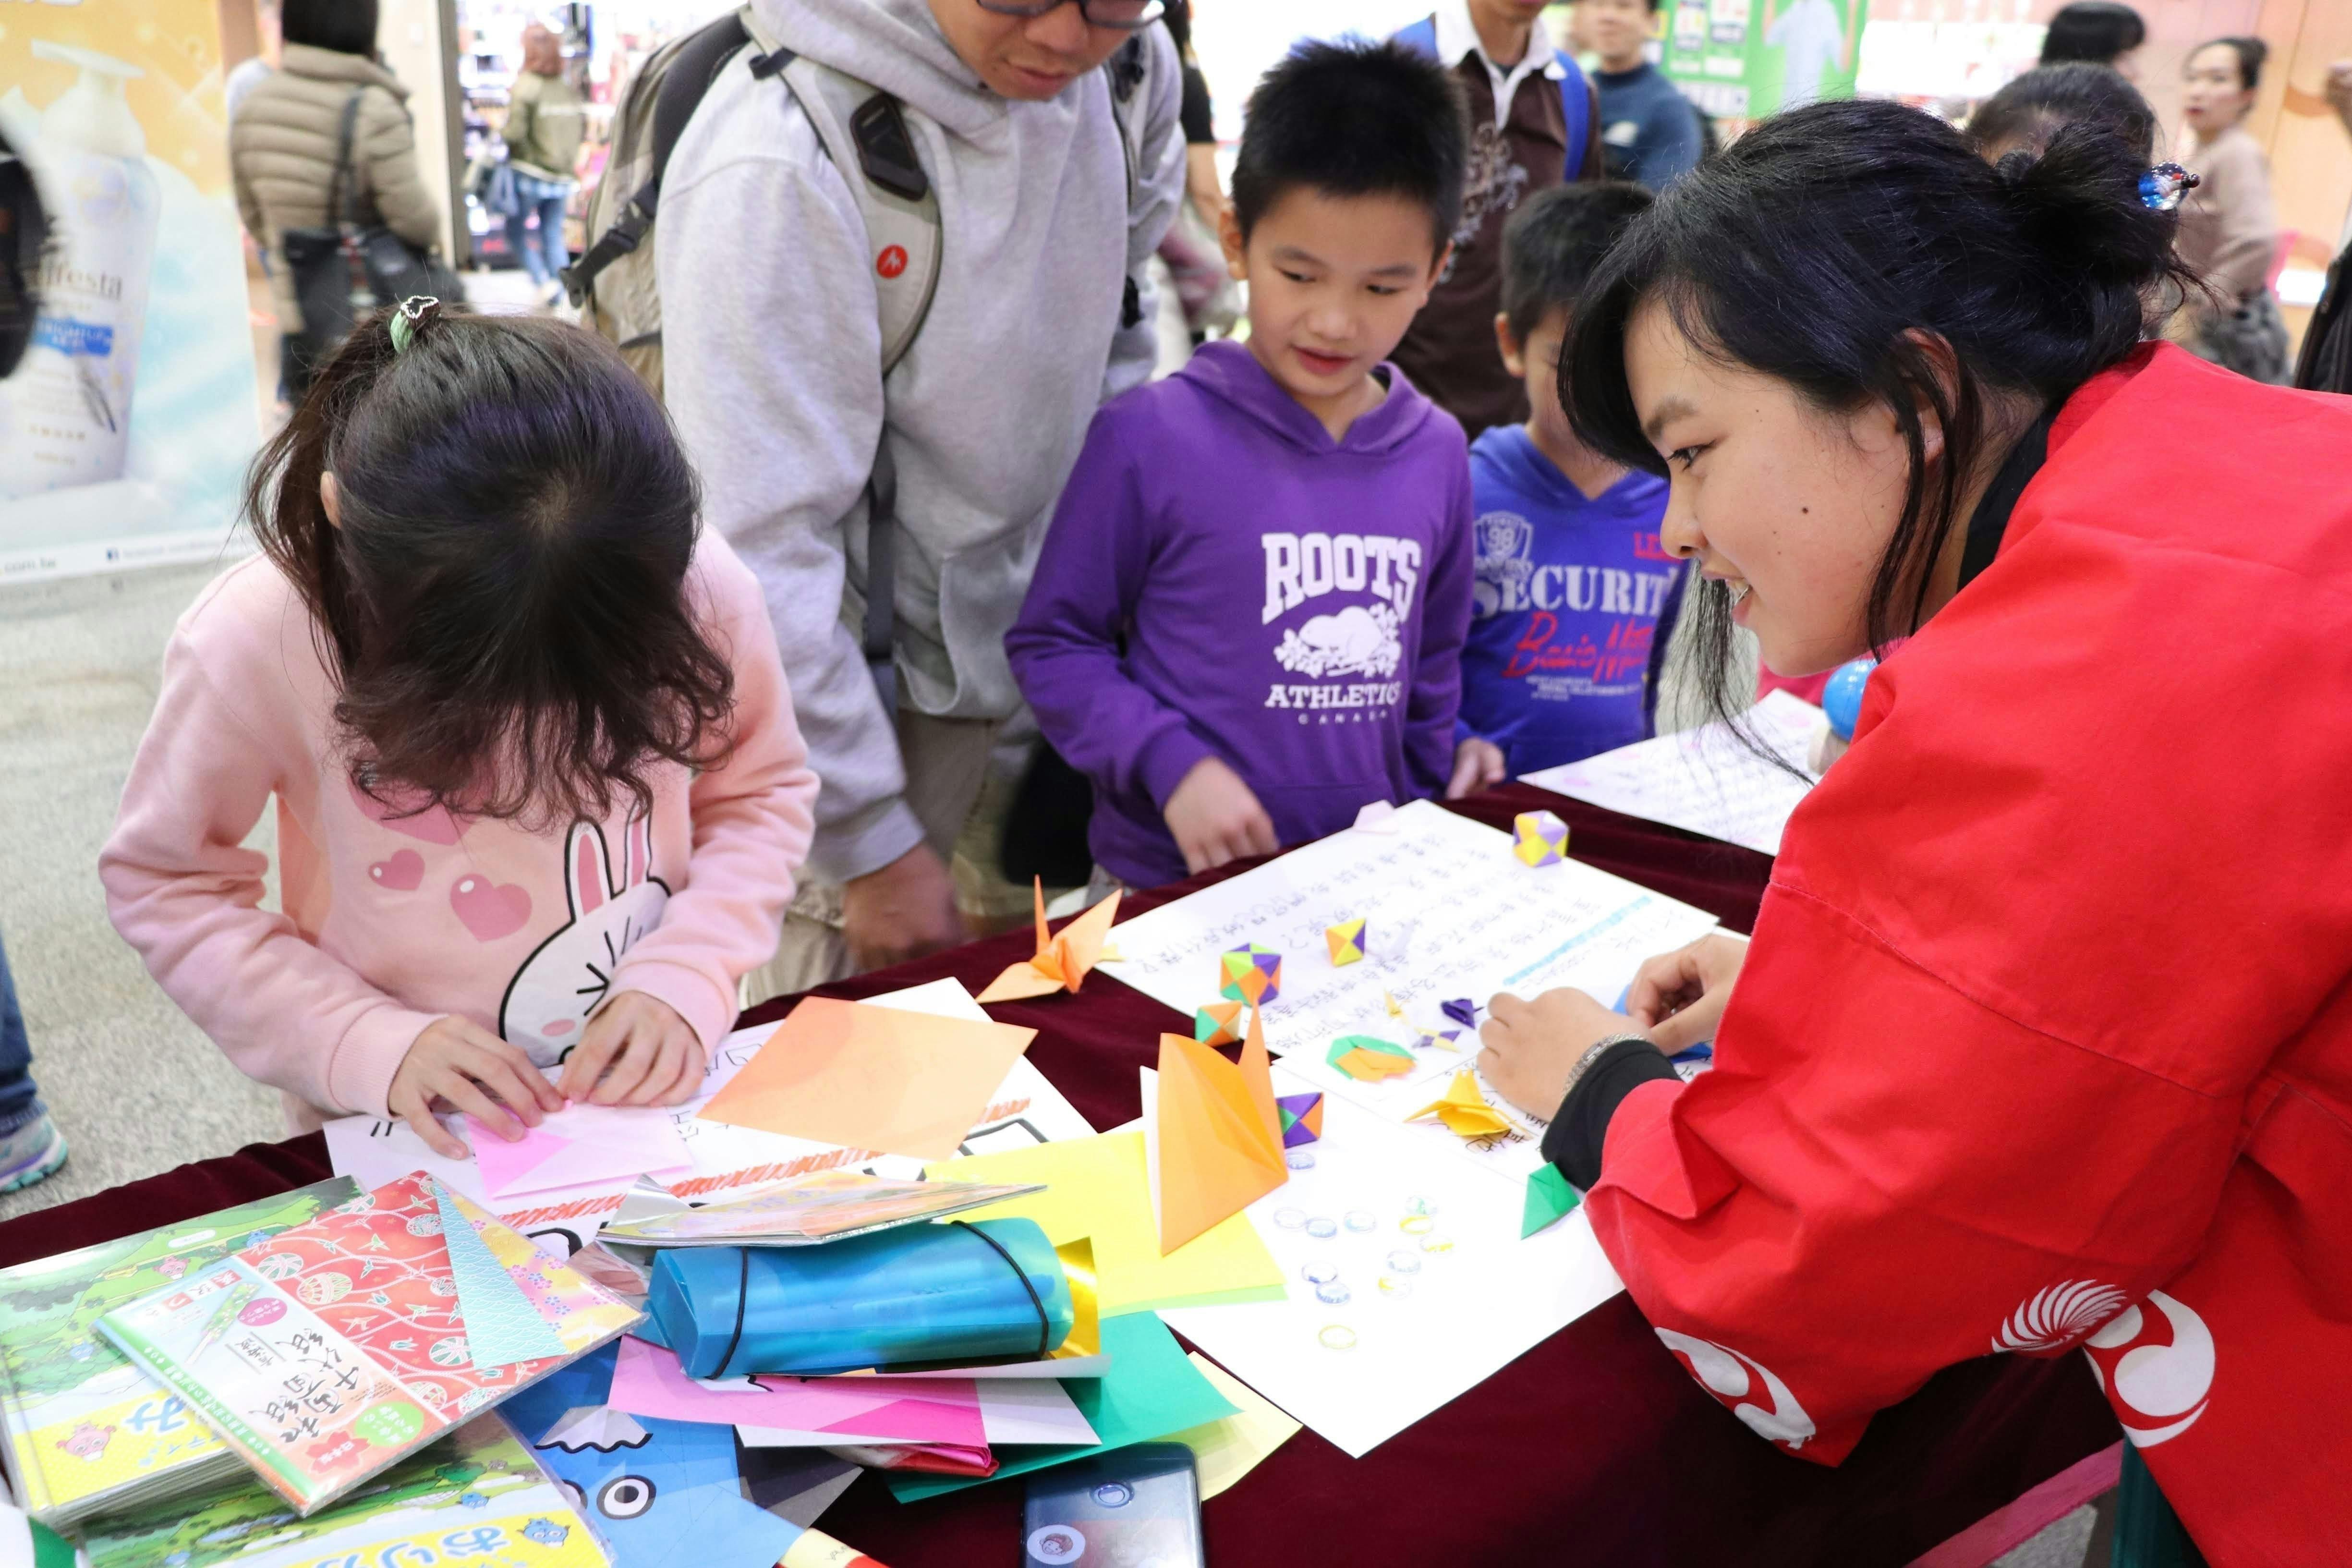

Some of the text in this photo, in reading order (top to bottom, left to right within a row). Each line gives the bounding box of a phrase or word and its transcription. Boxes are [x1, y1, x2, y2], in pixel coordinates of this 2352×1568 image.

[1261, 532, 1422, 625] ROOTS
[1475, 565, 1678, 620] SECURIT
[276, 1327, 359, 1389] 千代紙
[126, 1394, 186, 1433] み
[248, 1394, 319, 1443] 和紙
